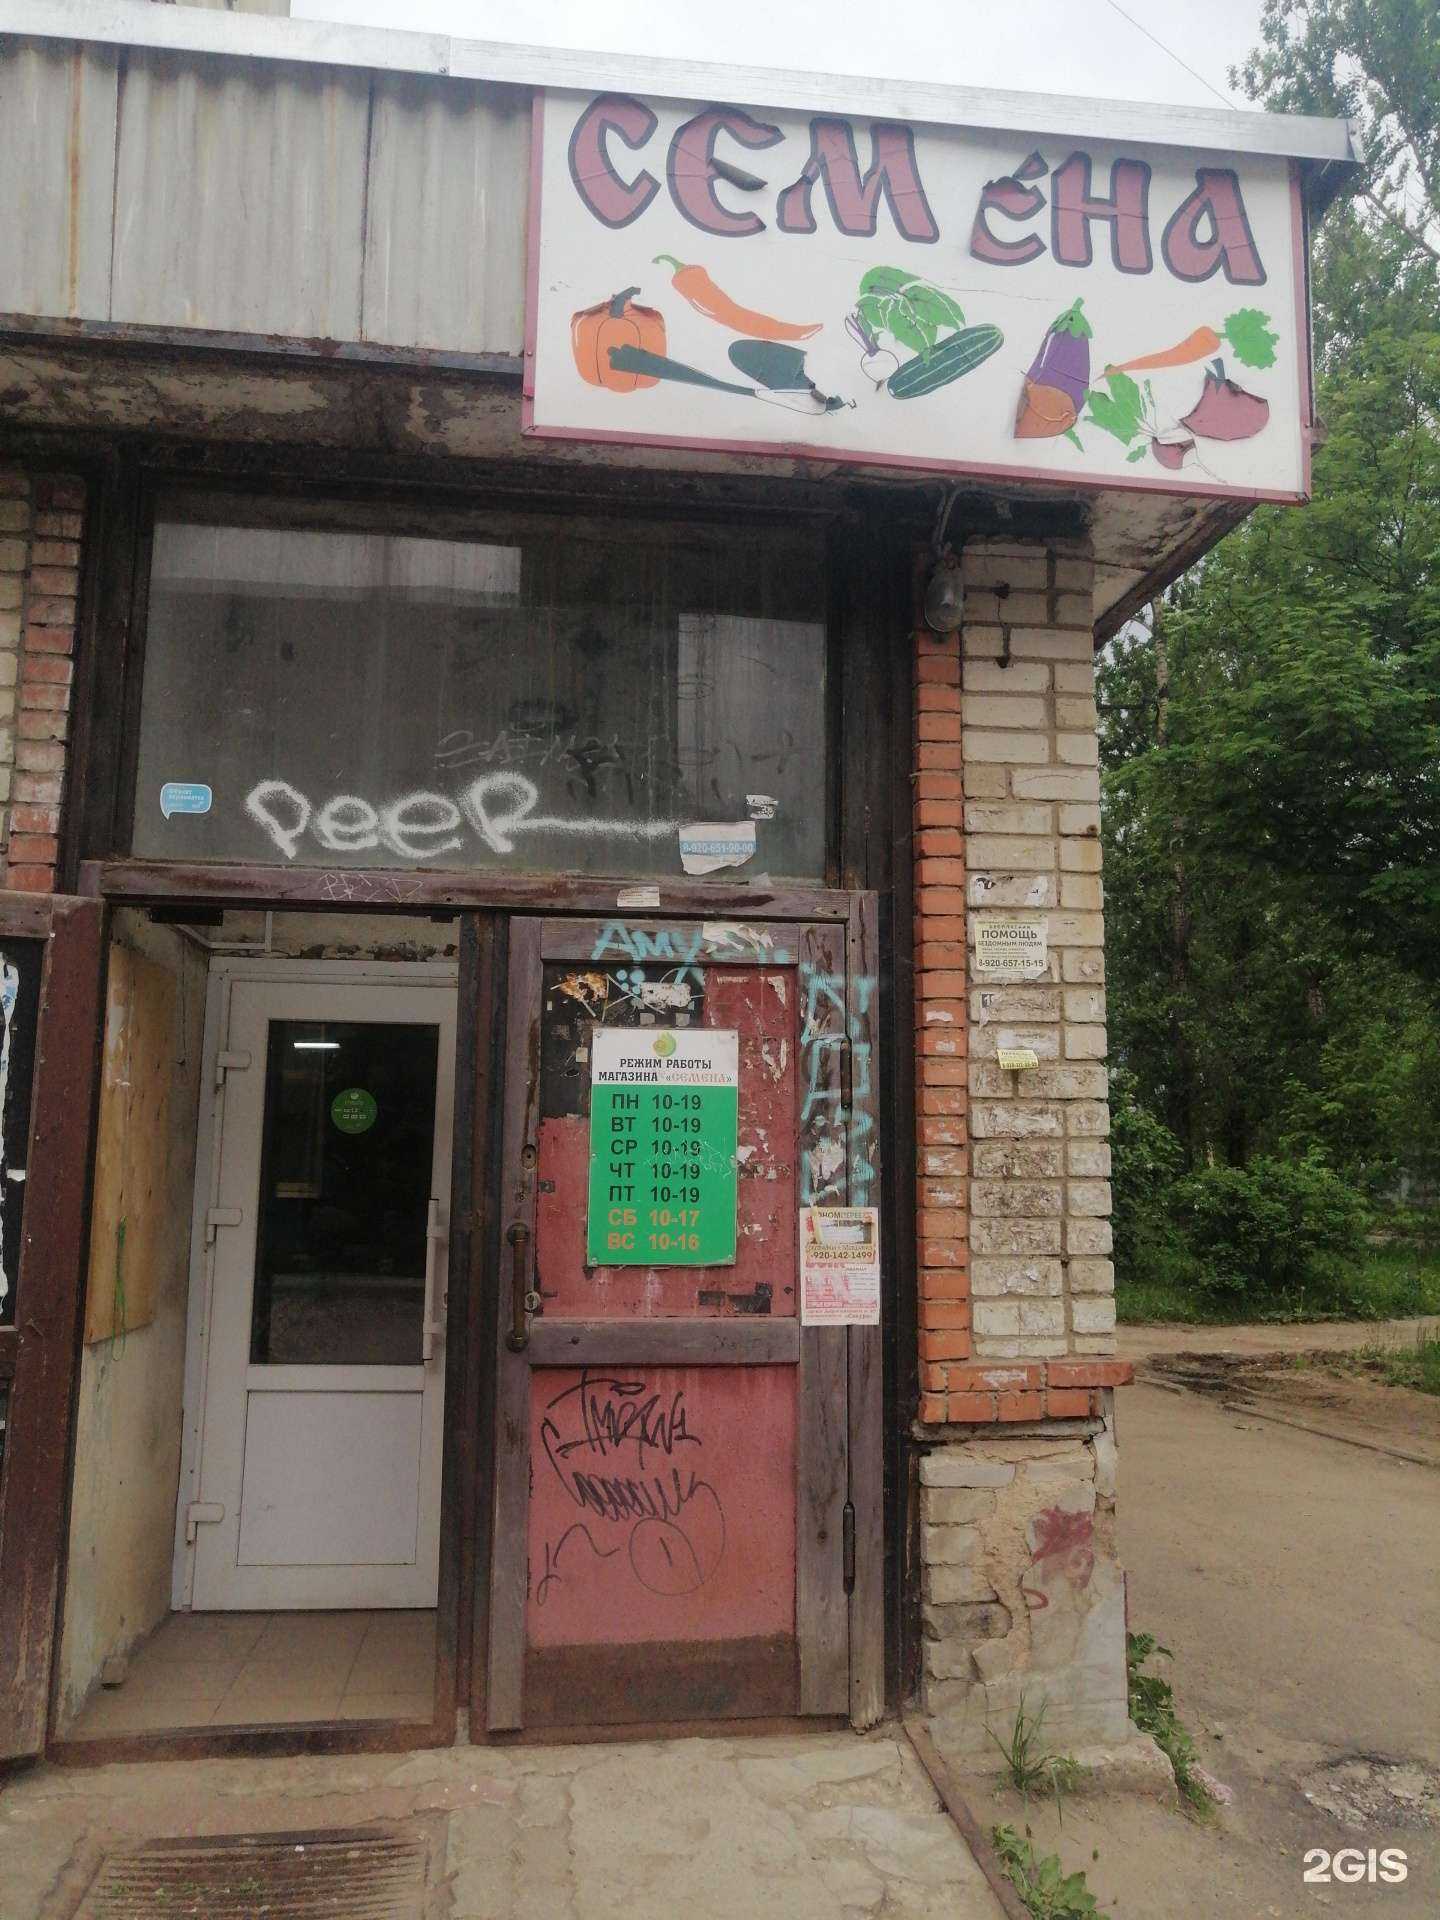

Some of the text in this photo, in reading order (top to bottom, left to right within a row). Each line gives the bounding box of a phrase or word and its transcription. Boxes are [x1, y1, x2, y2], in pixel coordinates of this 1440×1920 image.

[982, 930, 1037, 941] ПОМОЩЬ
[978, 959, 1044, 967] 8-920-657-15-15
[620, 1058, 712, 1070] РЕЖИМ РАБОТЫ
[598, 1071, 658, 1082] МАГАЗИНА
[611, 1093, 701, 1110] ПН 10-19
[611, 1116, 701, 1133] ВТ 10-19
[610, 1139, 701, 1156] СР 10-19
[609, 1162, 701, 1179] ЧТ 10-19
[609, 1185, 700, 1203] ПТ 10-19
[608, 1208, 700, 1227] СБ 10-17
[608, 1232, 699, 1251] ВС 10-16
